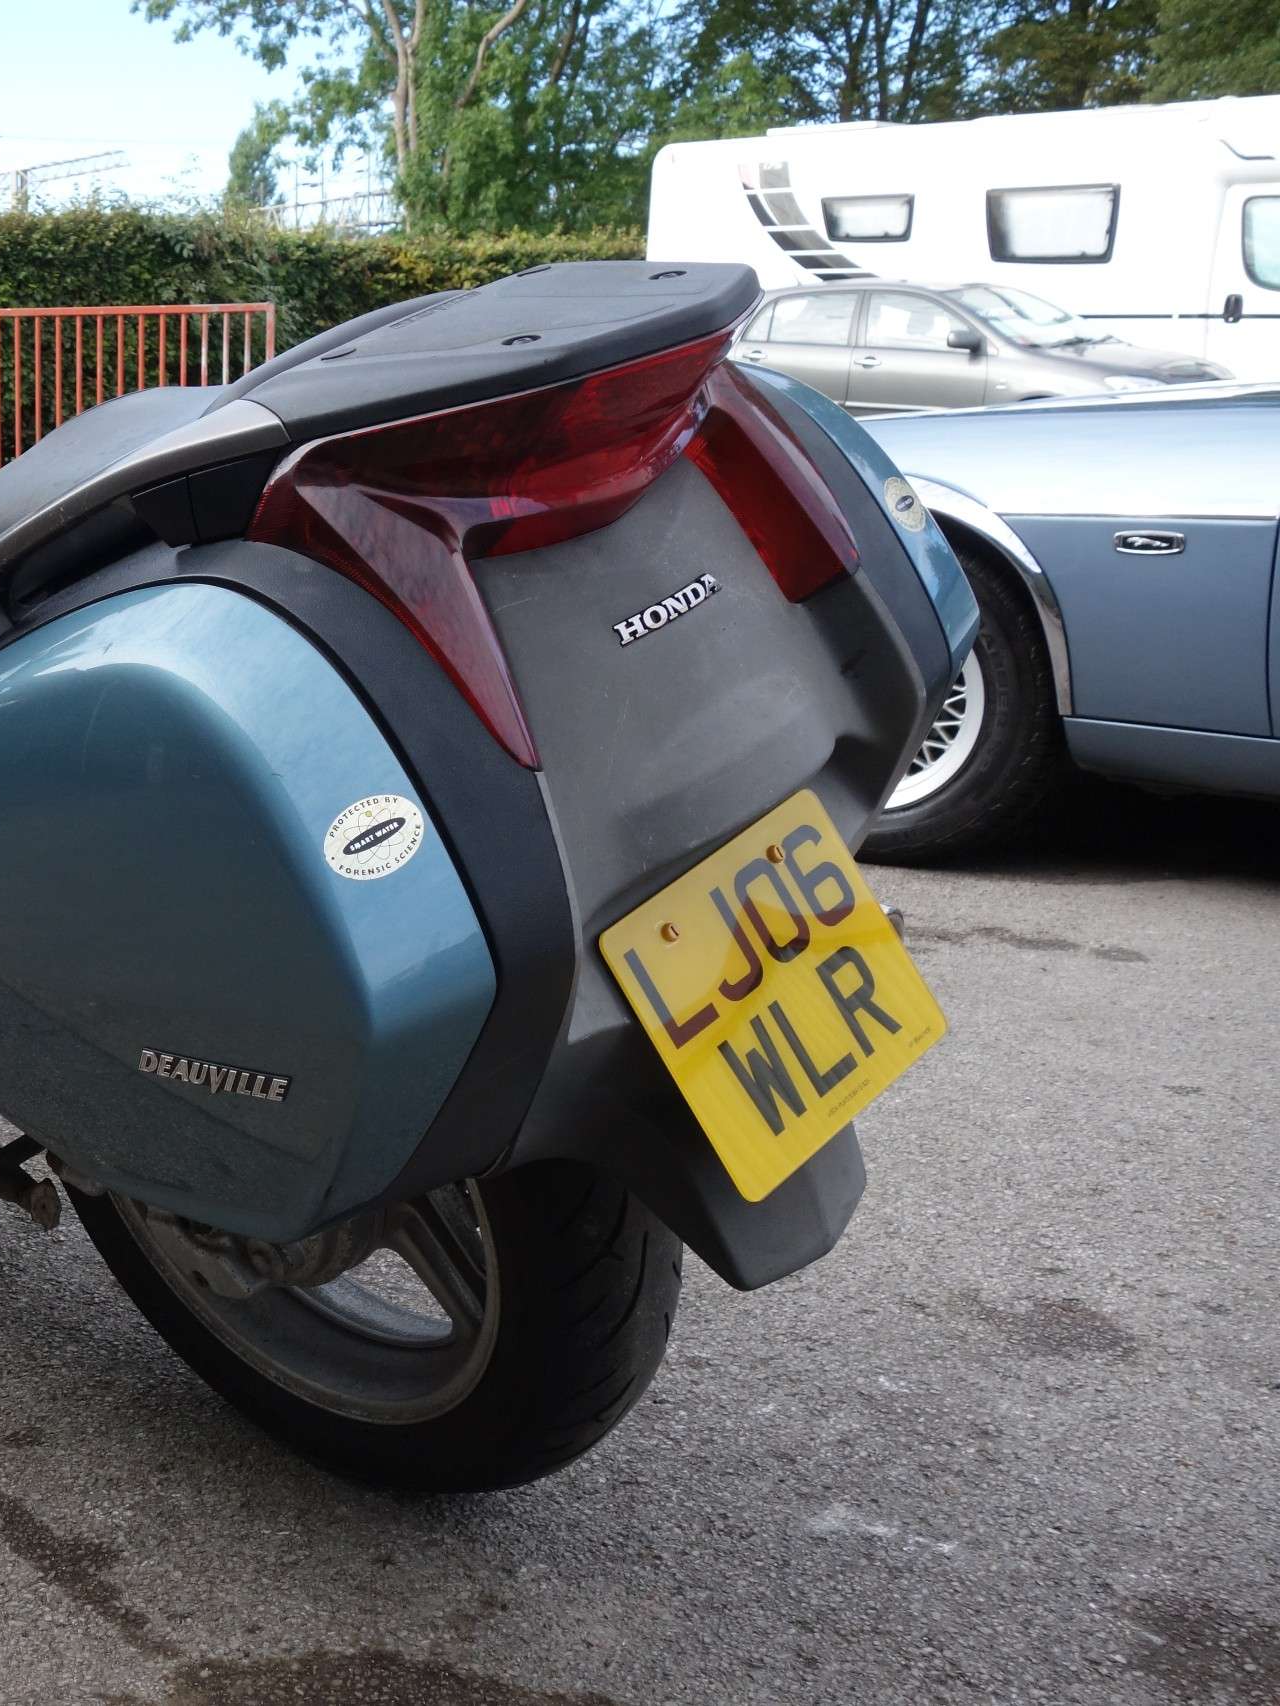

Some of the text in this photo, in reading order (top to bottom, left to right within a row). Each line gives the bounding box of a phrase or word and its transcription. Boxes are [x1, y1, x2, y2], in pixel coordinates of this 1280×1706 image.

[613, 573, 720, 645] HONDA
[329, 796, 398, 838] PROTECTED BY
[349, 821, 399, 852] SMART WATER
[338, 824, 421, 876] FORENSIC SCIENCE
[717, 945, 903, 1137] WLR
[138, 1049, 289, 1102] DEAUVILLE
